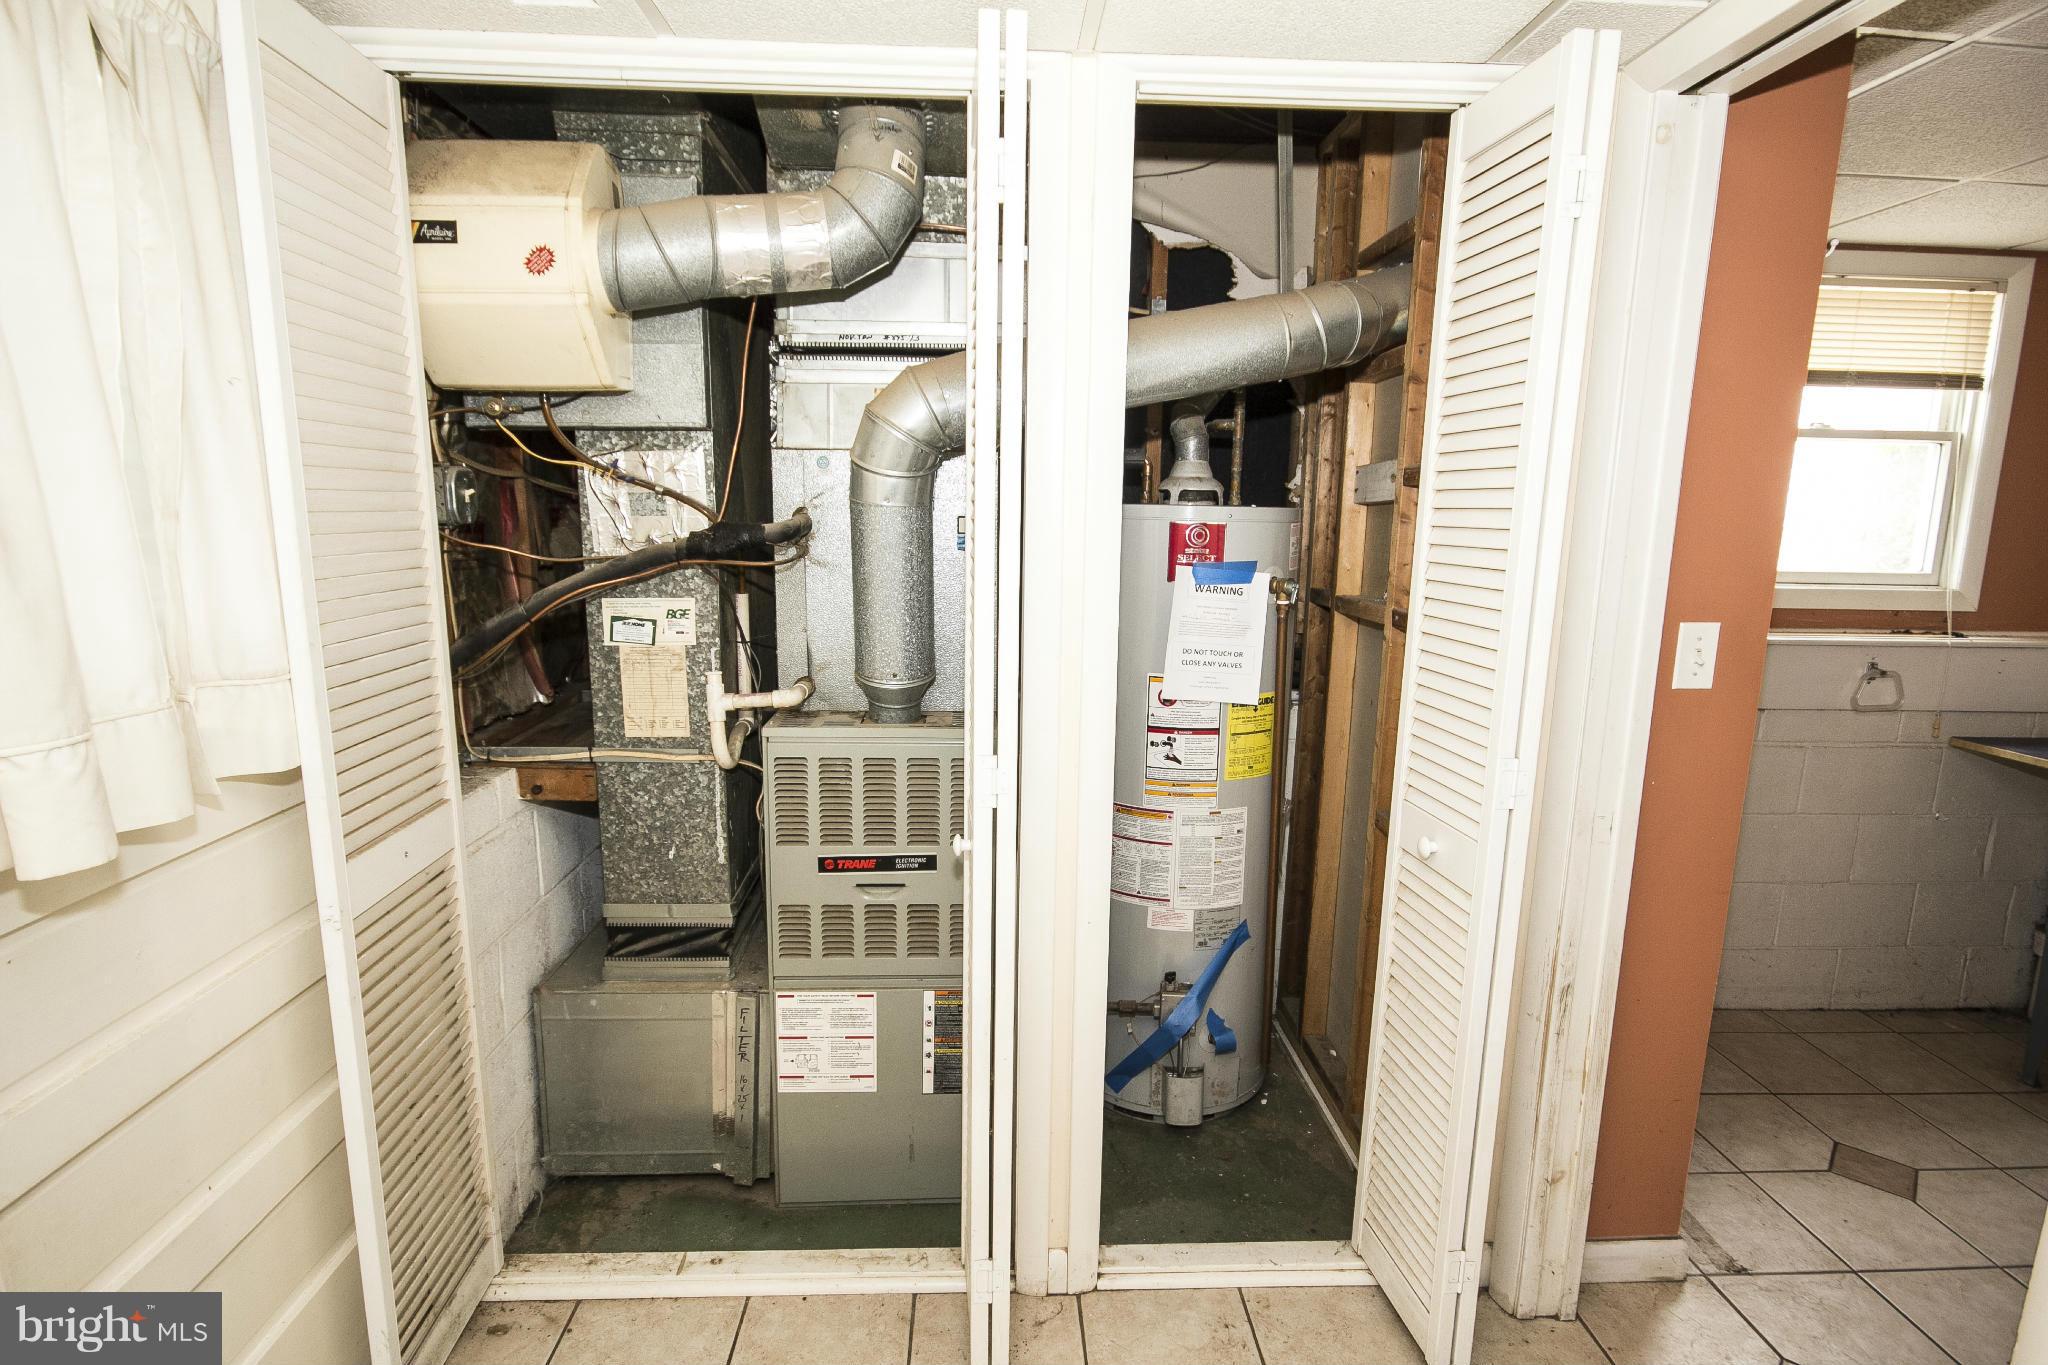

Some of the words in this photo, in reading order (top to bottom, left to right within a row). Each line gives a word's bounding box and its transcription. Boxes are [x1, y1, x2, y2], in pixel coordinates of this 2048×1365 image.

[1177, 554, 1217, 562] SELECT
[1194, 583, 1244, 597] WARNING
[666, 608, 691, 620] BGE
[1182, 647, 1193, 655] DO
[1210, 649, 1232, 657] TOUCH
[1181, 659, 1201, 667] CLOSE
[1217, 661, 1243, 669] VALVES
[837, 859, 877, 869] TRANE
[737, 1007, 753, 1063] FILTER
